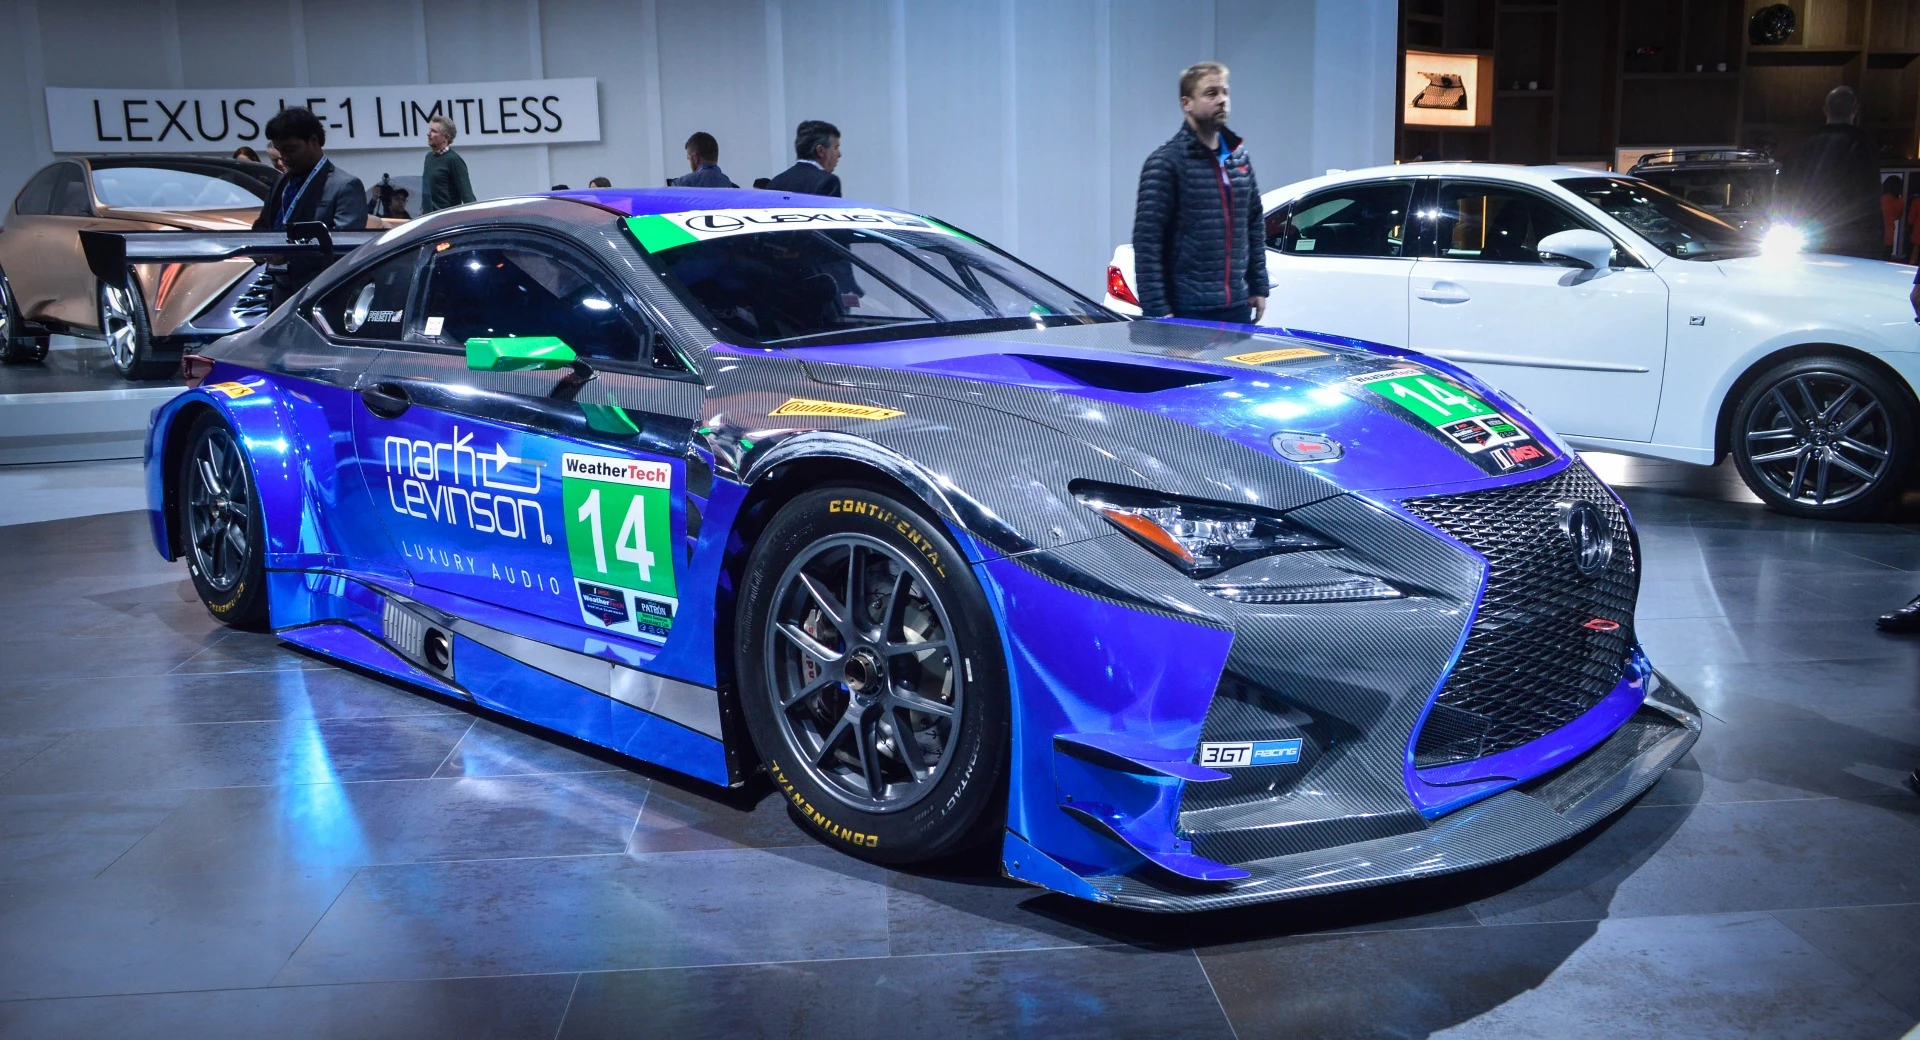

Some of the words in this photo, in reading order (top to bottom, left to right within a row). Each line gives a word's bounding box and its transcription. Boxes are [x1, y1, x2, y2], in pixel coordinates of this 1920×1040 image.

[93, 98, 260, 143] LEXUS
[377, 94, 564, 139] LIMITLESS
[742, 212, 884, 225] LEXUS
[1389, 377, 1479, 417] 14
[566, 457, 667, 483] WeatherTech
[577, 488, 656, 583] 14
[401, 539, 476, 575] LUXURY
[491, 563, 560, 596] AUDIO
[1204, 747, 1250, 763] 3GT
[771, 759, 879, 849] CONTINENTAL
